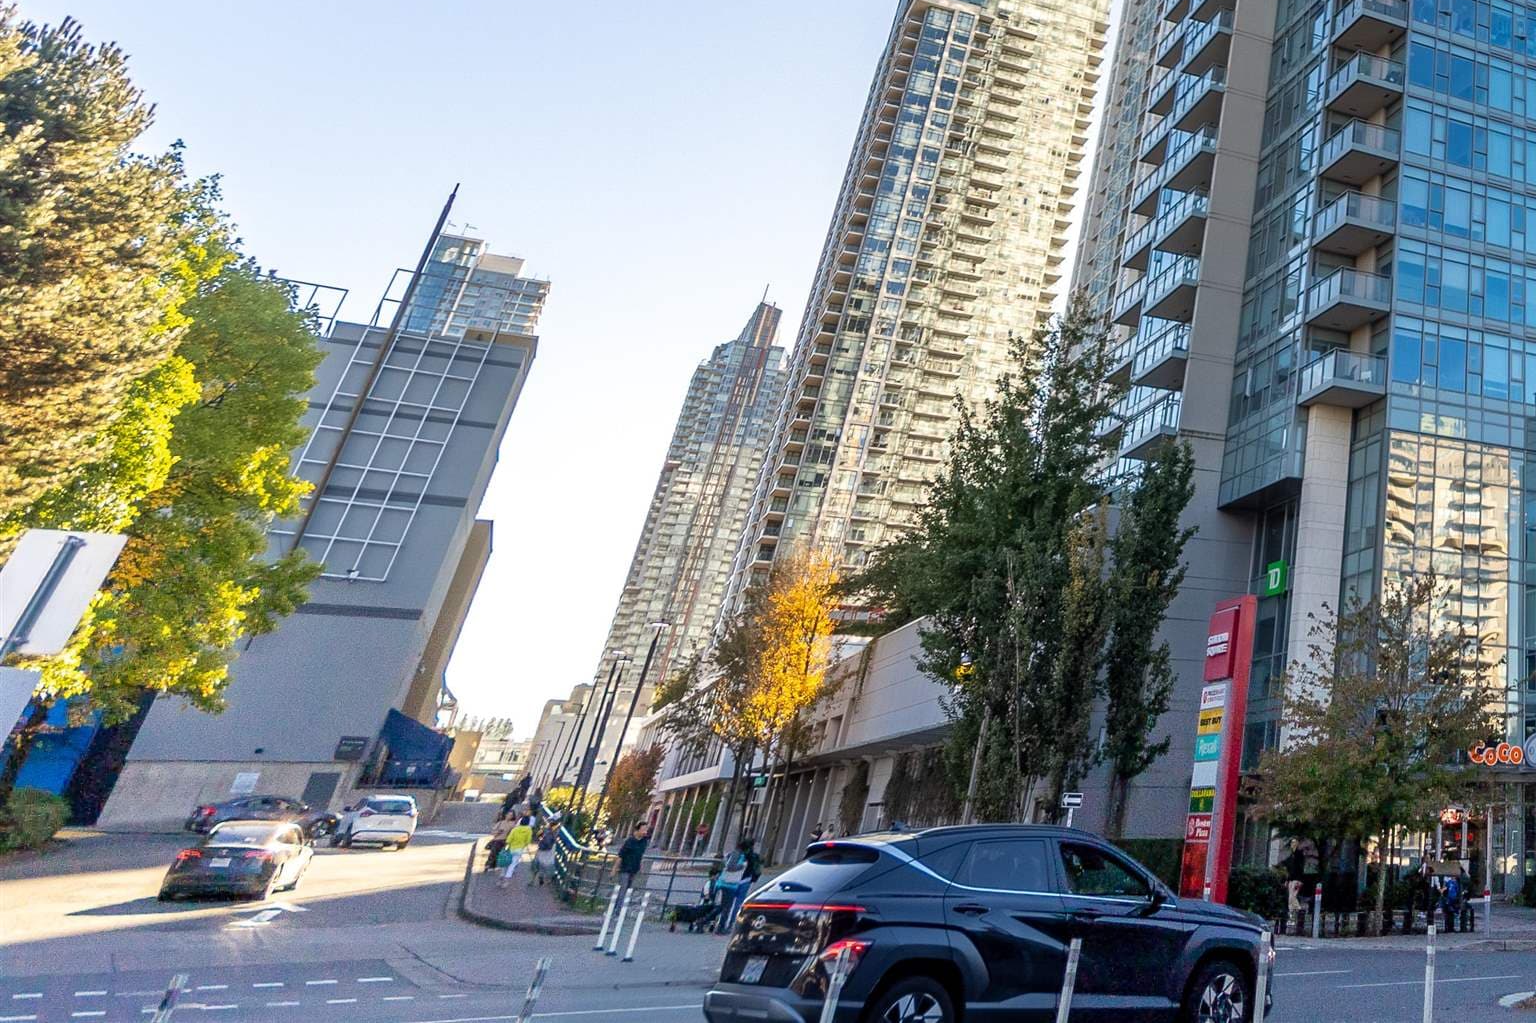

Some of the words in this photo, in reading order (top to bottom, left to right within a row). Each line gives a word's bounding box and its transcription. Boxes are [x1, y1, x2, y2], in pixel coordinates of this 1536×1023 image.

[1268, 568, 1280, 590] TD
[1200, 718, 1211, 726] BEST
[1211, 716, 1222, 725] BUY
